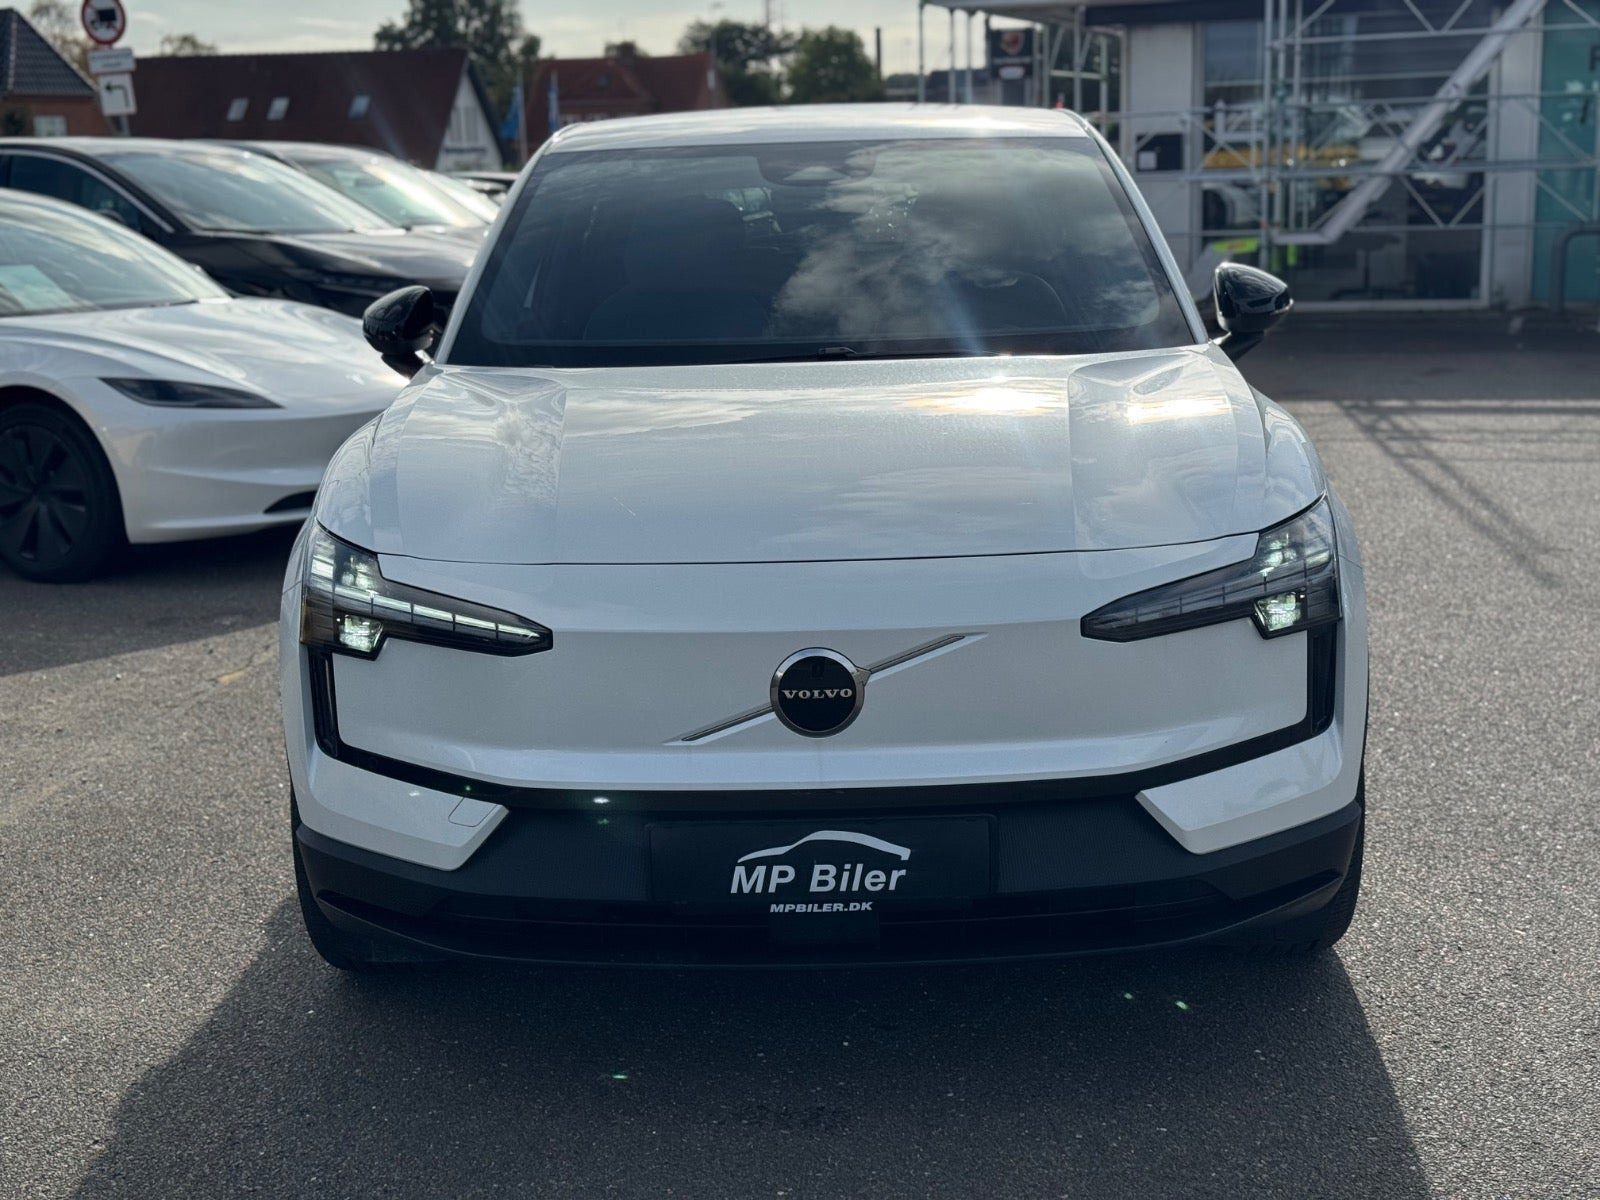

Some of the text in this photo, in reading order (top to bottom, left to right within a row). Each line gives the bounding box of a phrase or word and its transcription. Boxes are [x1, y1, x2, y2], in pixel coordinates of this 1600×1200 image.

[781, 688, 853, 699] VOLVO
[730, 863, 907, 894] MP Biler
[769, 901, 874, 913] MPBILER.DK
